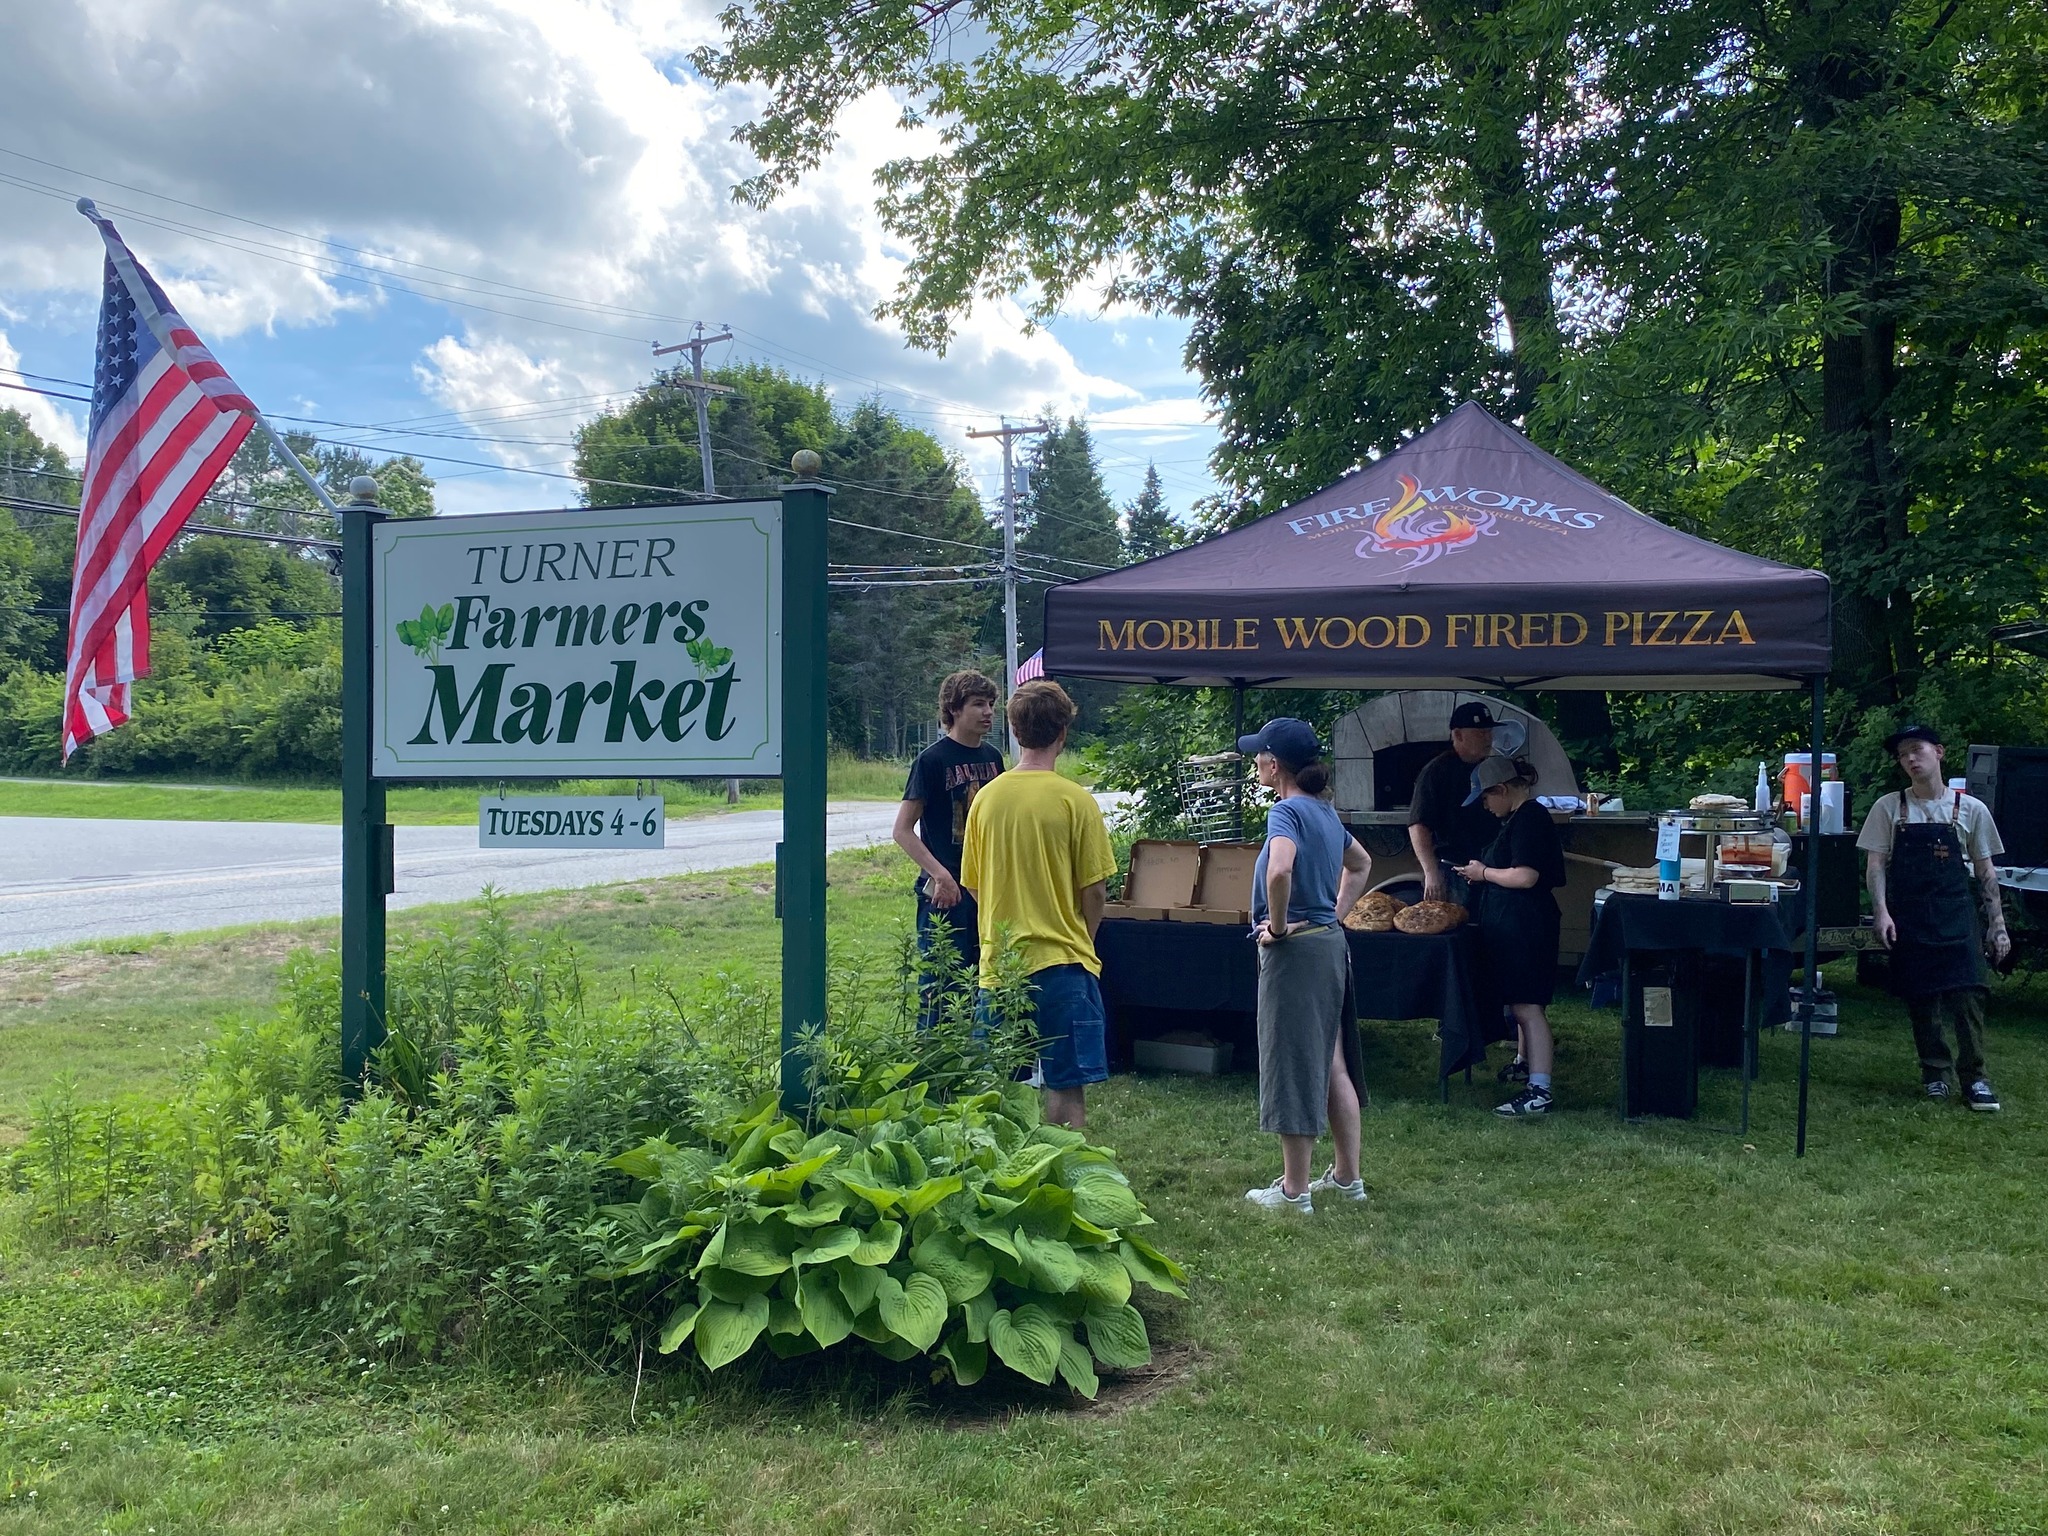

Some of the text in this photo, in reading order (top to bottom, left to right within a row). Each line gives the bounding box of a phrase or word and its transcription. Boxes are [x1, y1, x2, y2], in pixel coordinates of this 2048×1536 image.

[1285, 486, 1605, 536] FIRE WORKS
[1307, 519, 1369, 541] MOBILE
[1528, 519, 1569, 536] PIZZA
[466, 537, 676, 585] TURNER
[445, 595, 709, 650] Farmers
[1097, 609, 1756, 650] MOBILE WOOD FIRED PIZZA
[406, 660, 742, 745] Market
[487, 808, 605, 836] TUESDAYS
